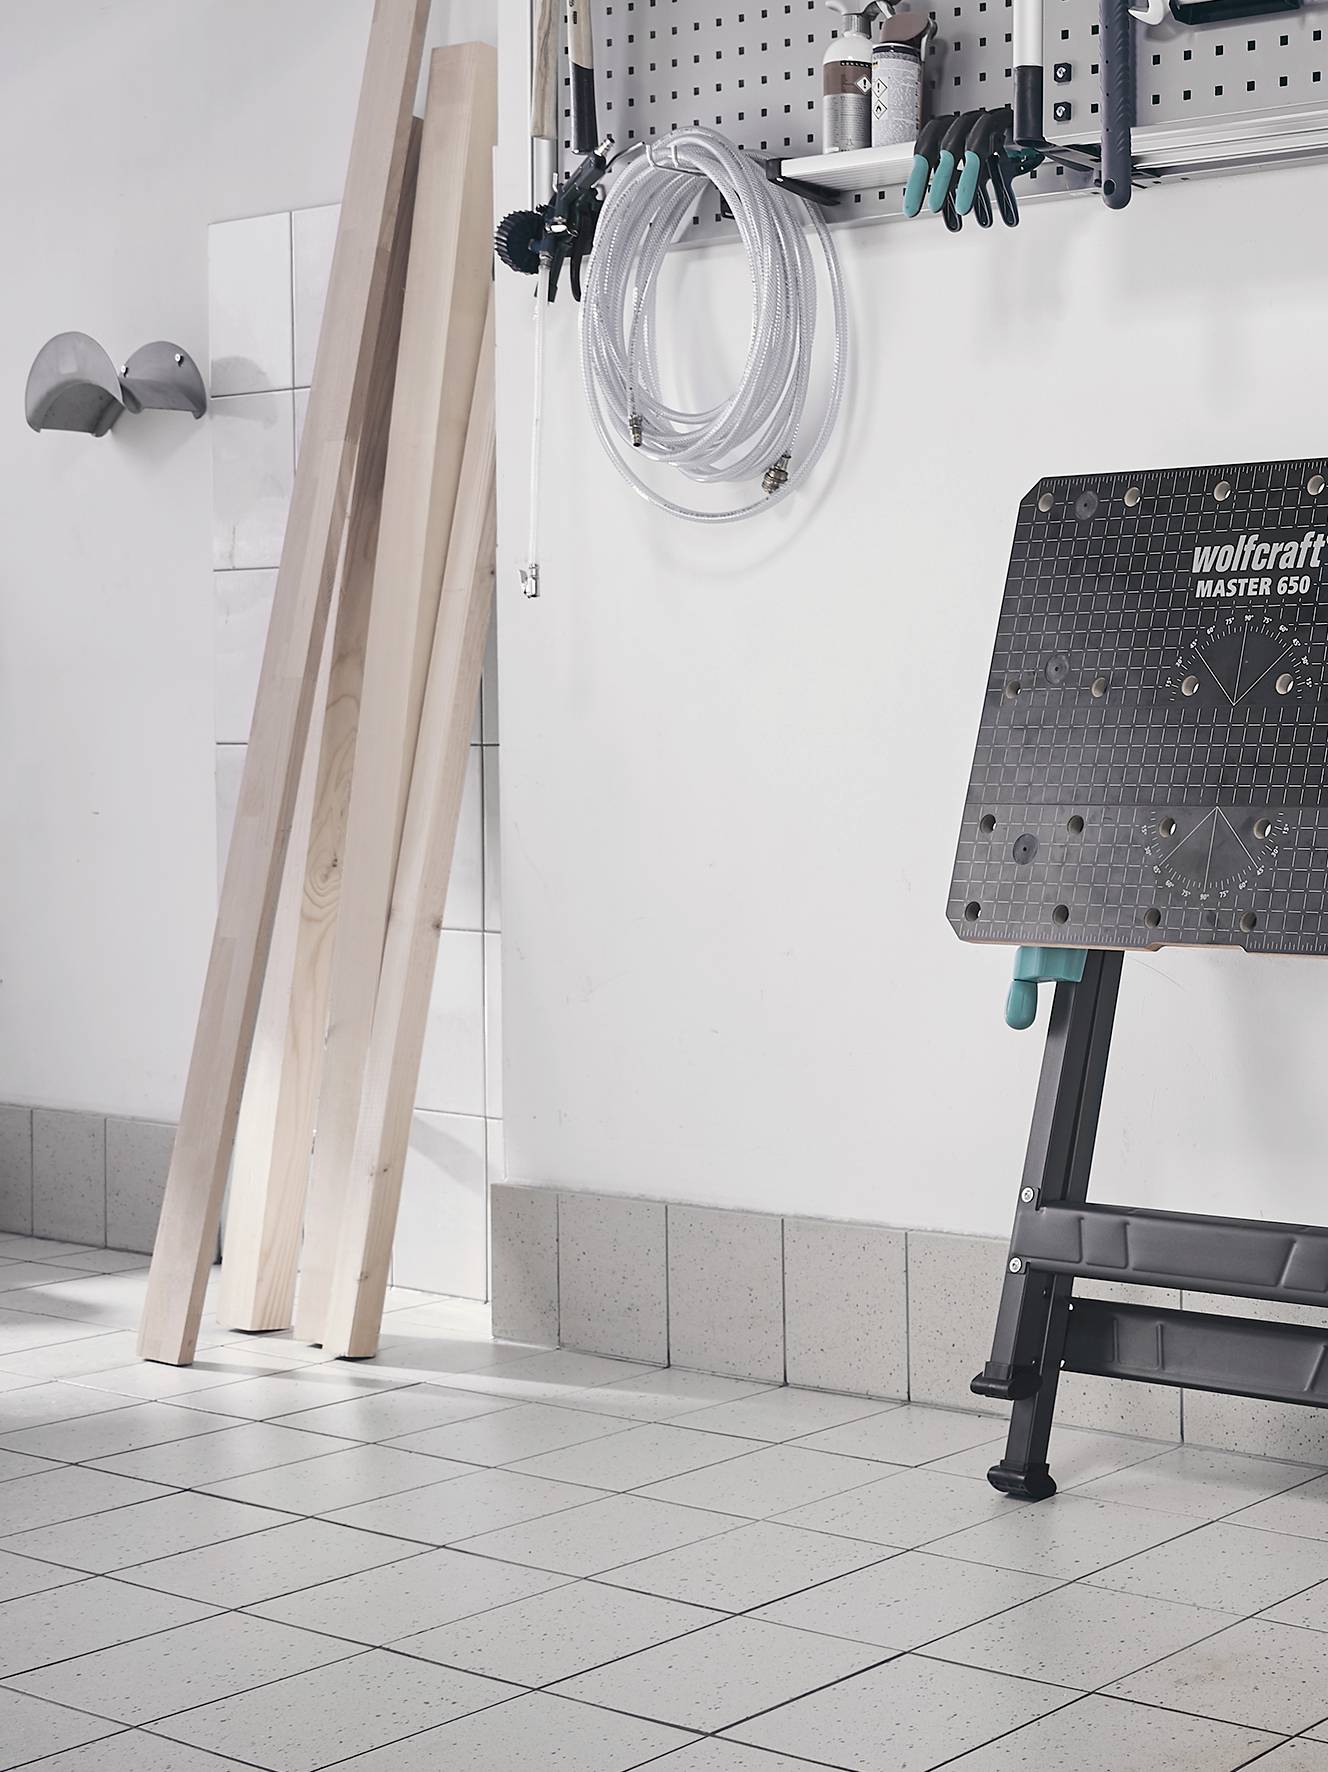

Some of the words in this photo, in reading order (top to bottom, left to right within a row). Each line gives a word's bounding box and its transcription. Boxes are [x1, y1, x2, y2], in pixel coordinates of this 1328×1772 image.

[1195, 577, 1272, 598] MASTER
[1276, 576, 1311, 595] 650
[1190, 639, 1198, 648] 45°
[1207, 625, 1215, 634] 60°
[1225, 617, 1234, 625] 75°
[1279, 625, 1288, 633] 60°
[1292, 639, 1301, 647] 45°
[1181, 889, 1191, 897] 75°
[1219, 890, 1229, 898] 75°
[1239, 880, 1248, 890] 60°
[1256, 865, 1265, 875] 45°
[1271, 846, 1279, 857] 30°
